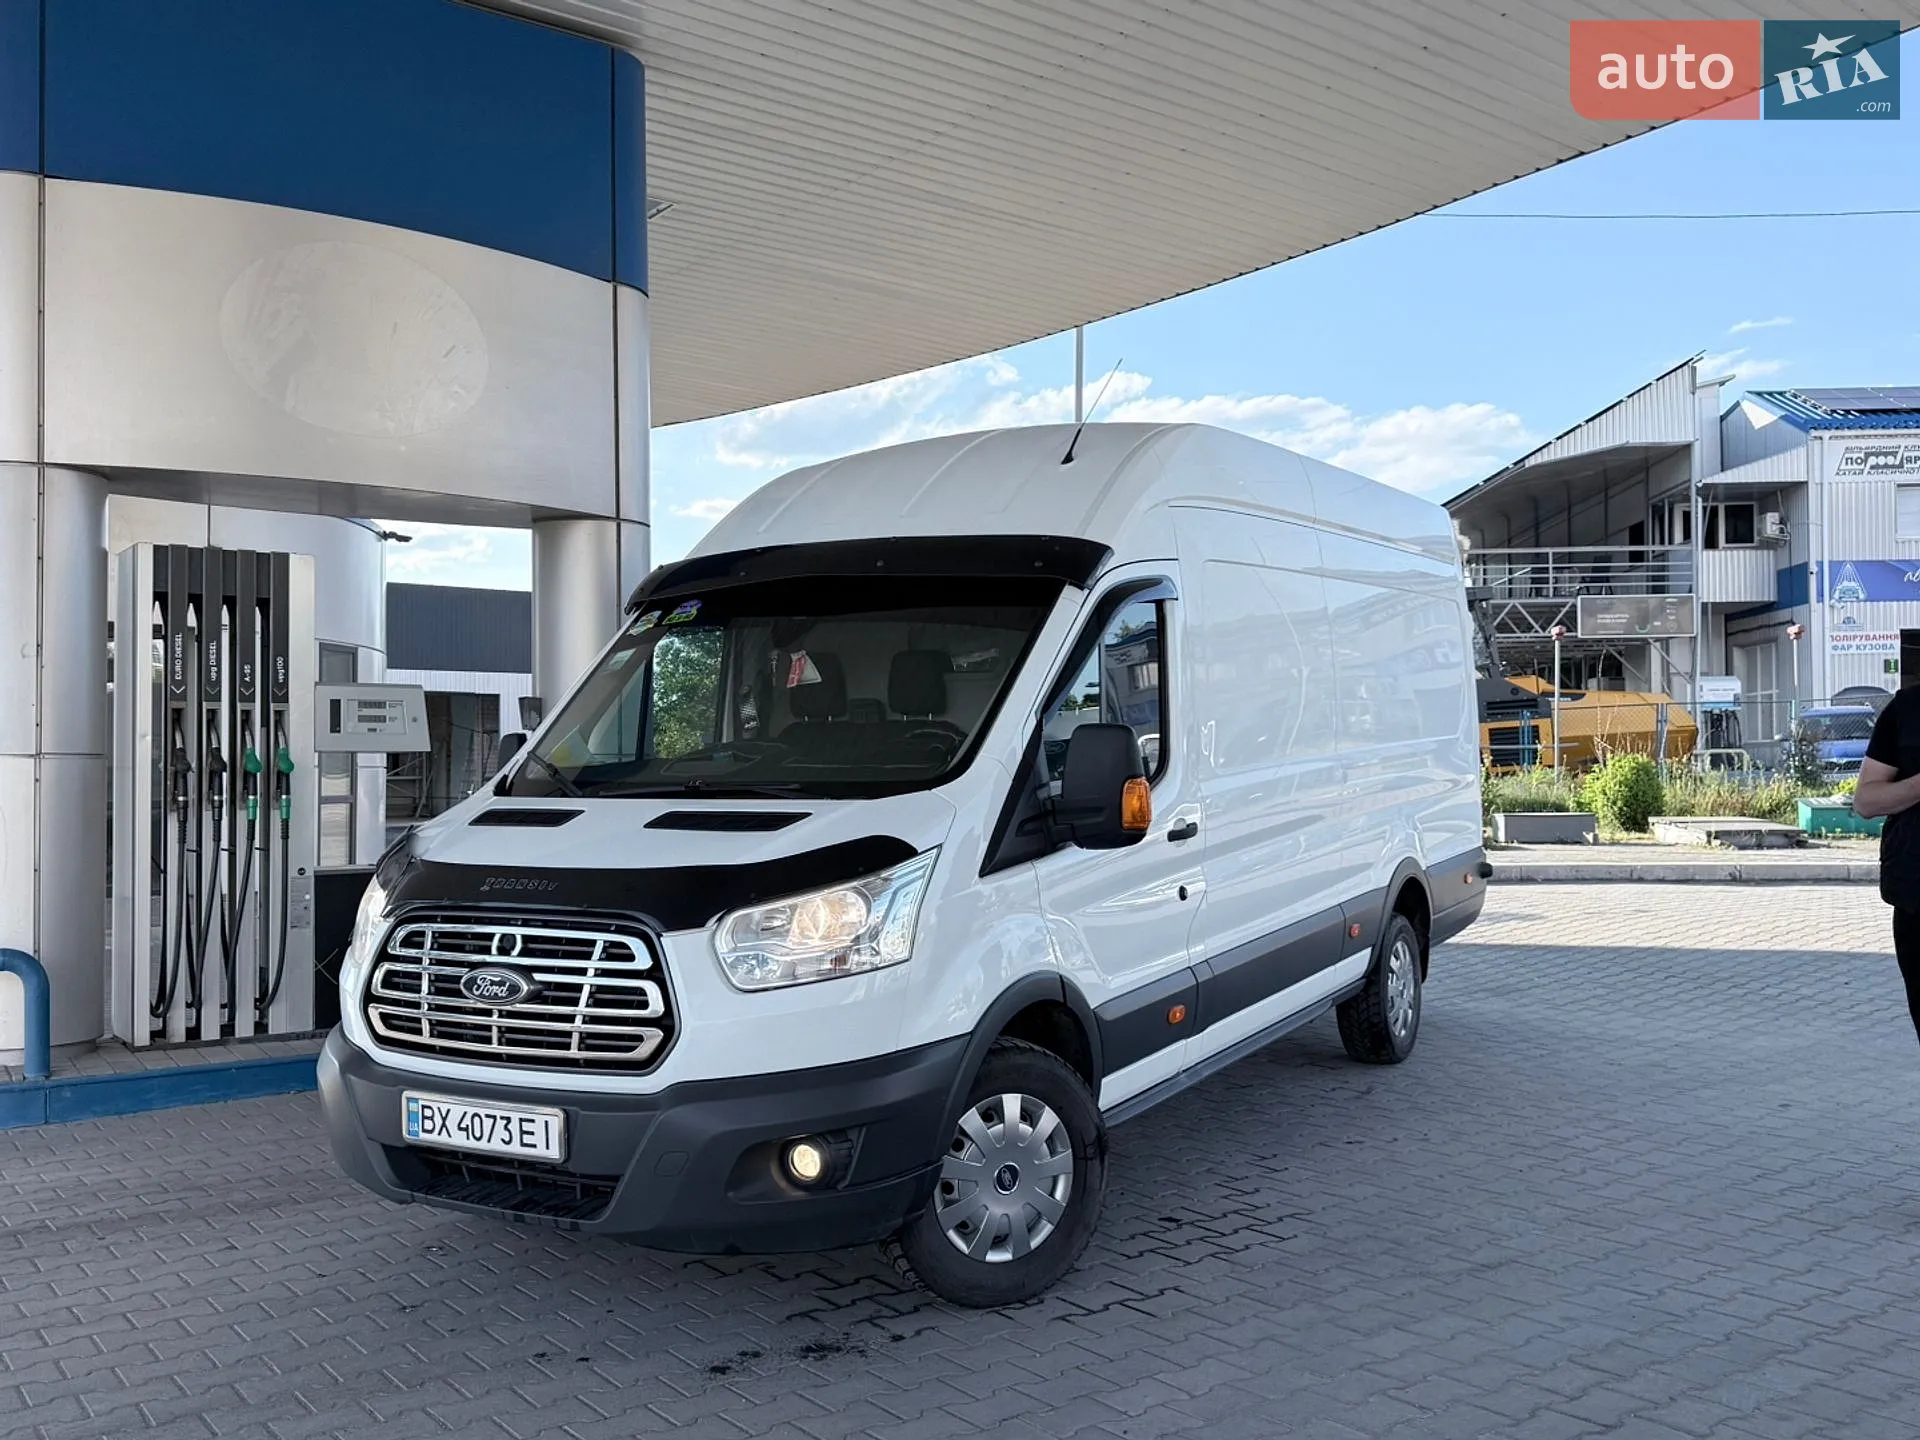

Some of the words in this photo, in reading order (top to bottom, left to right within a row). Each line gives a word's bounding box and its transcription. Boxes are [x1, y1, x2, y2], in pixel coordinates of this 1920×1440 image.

[209, 640, 217, 666] DIESEL
[1855, 643, 1896, 651] КУЗОВА
[472, 975, 511, 997] Ford
